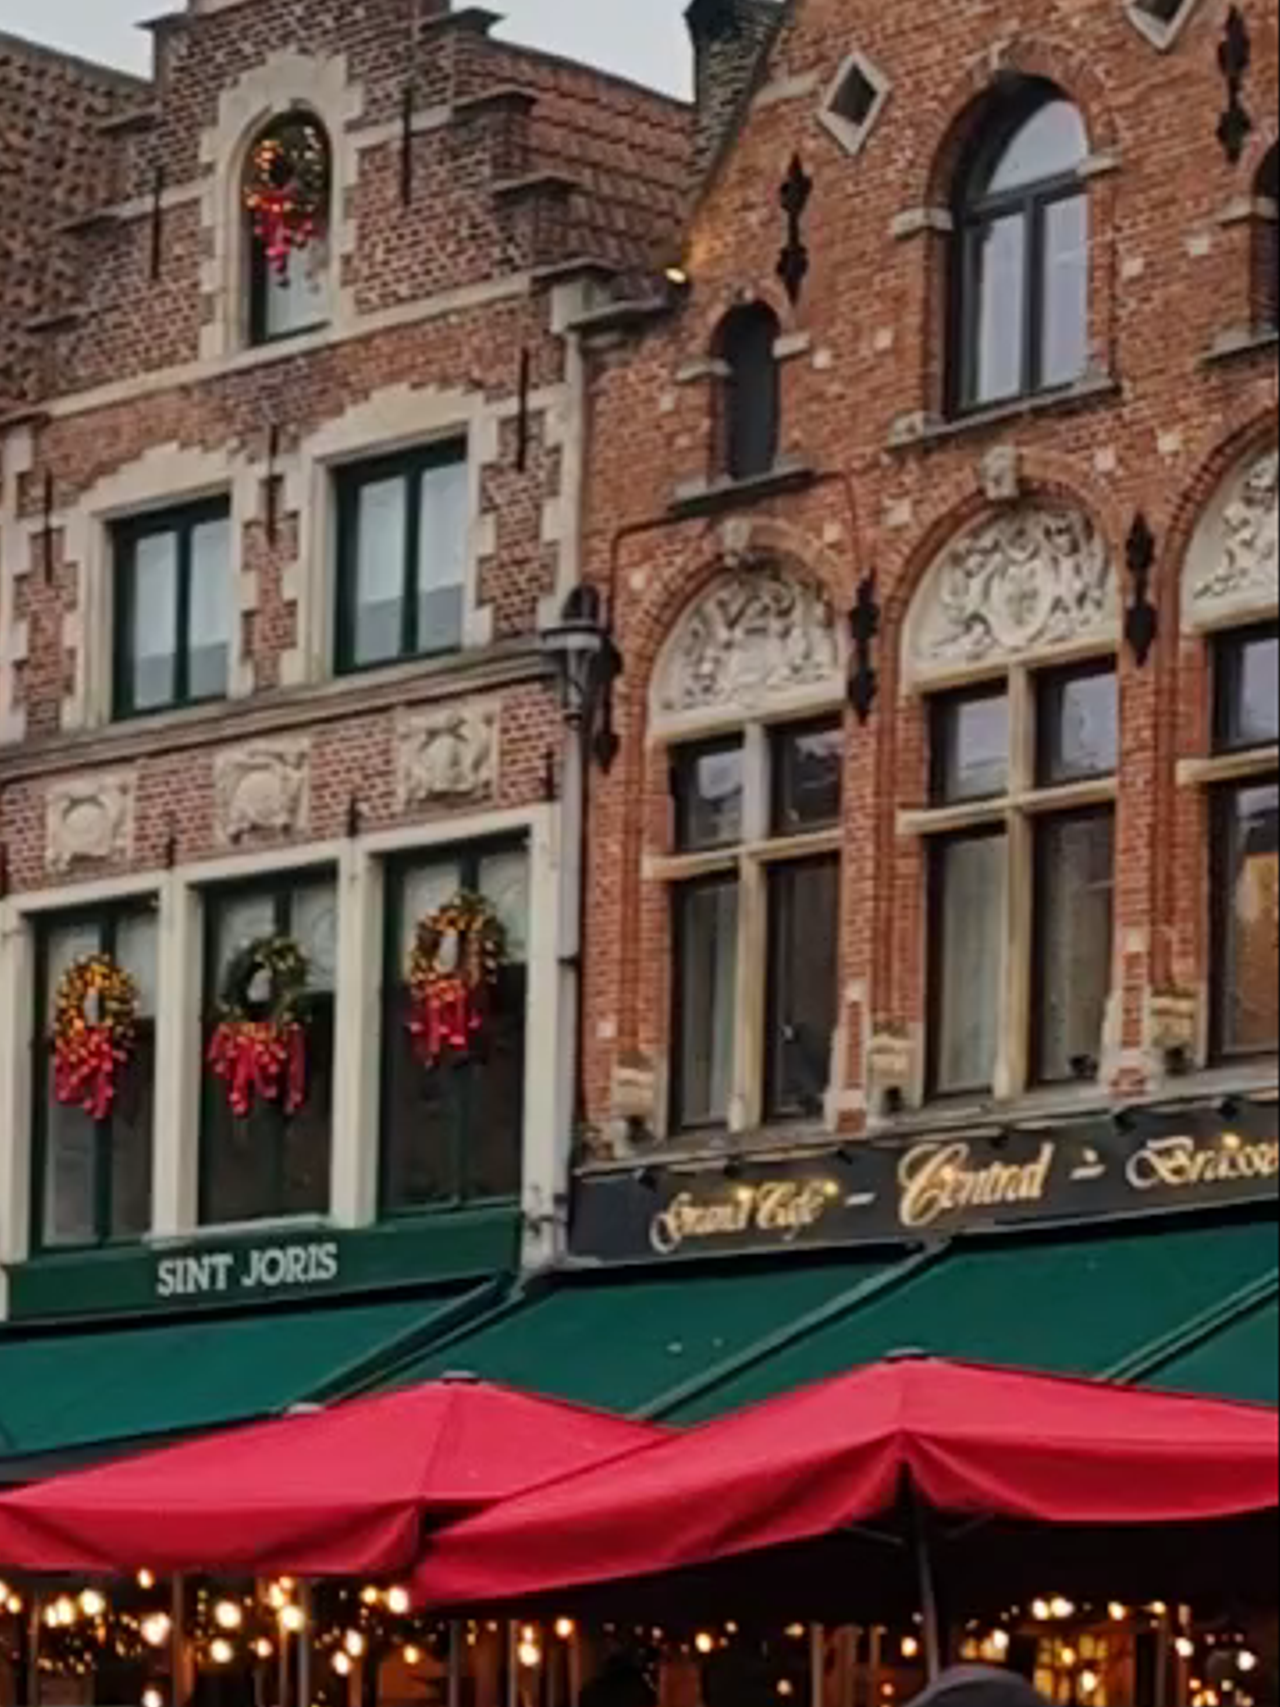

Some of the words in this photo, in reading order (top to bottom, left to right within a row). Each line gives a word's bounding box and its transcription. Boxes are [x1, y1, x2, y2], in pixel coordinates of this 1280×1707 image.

[896, 1141, 1055, 1228] Central
[156, 1252, 235, 1297] SINT
[241, 1242, 338, 1288] JORIS
